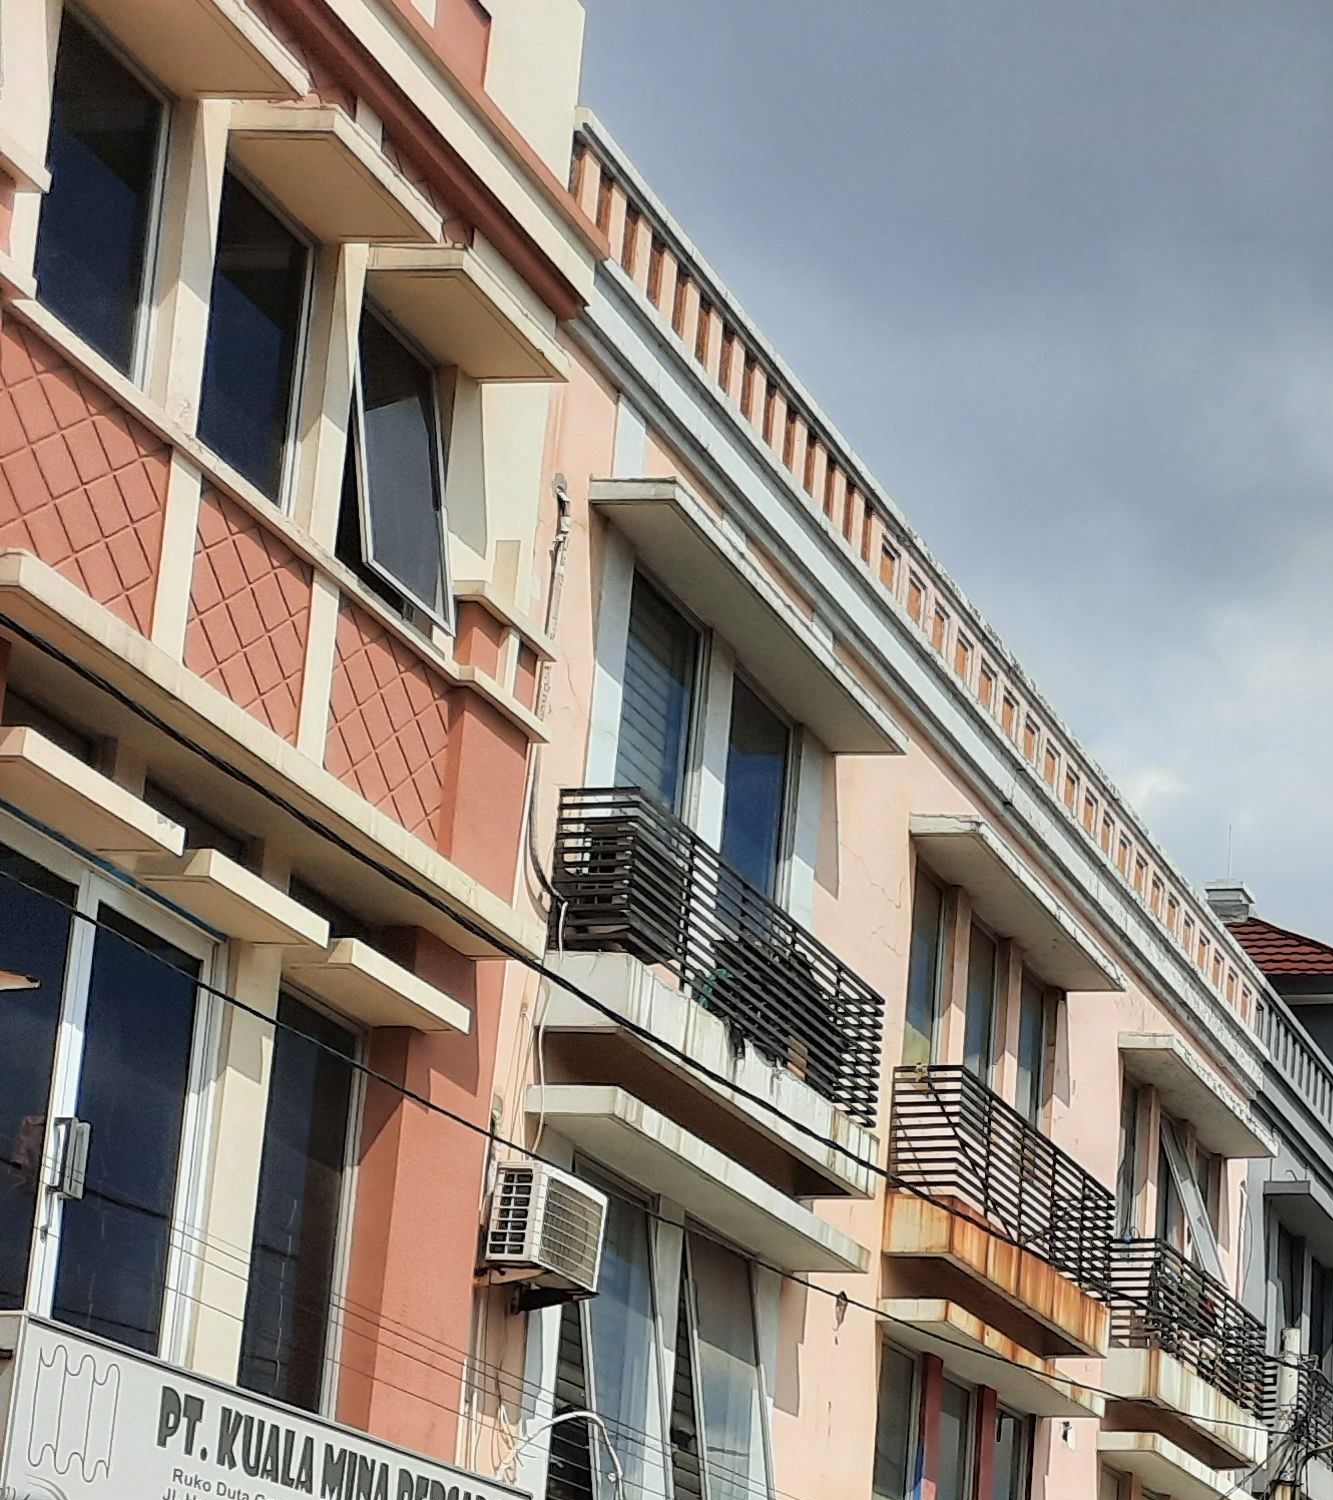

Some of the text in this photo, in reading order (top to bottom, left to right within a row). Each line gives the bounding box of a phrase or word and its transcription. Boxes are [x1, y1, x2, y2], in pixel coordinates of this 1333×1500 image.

[157, 1385, 208, 1461] PT.
[216, 1406, 314, 1495] KUALA
[172, 1468, 212, 1493] Ruko
